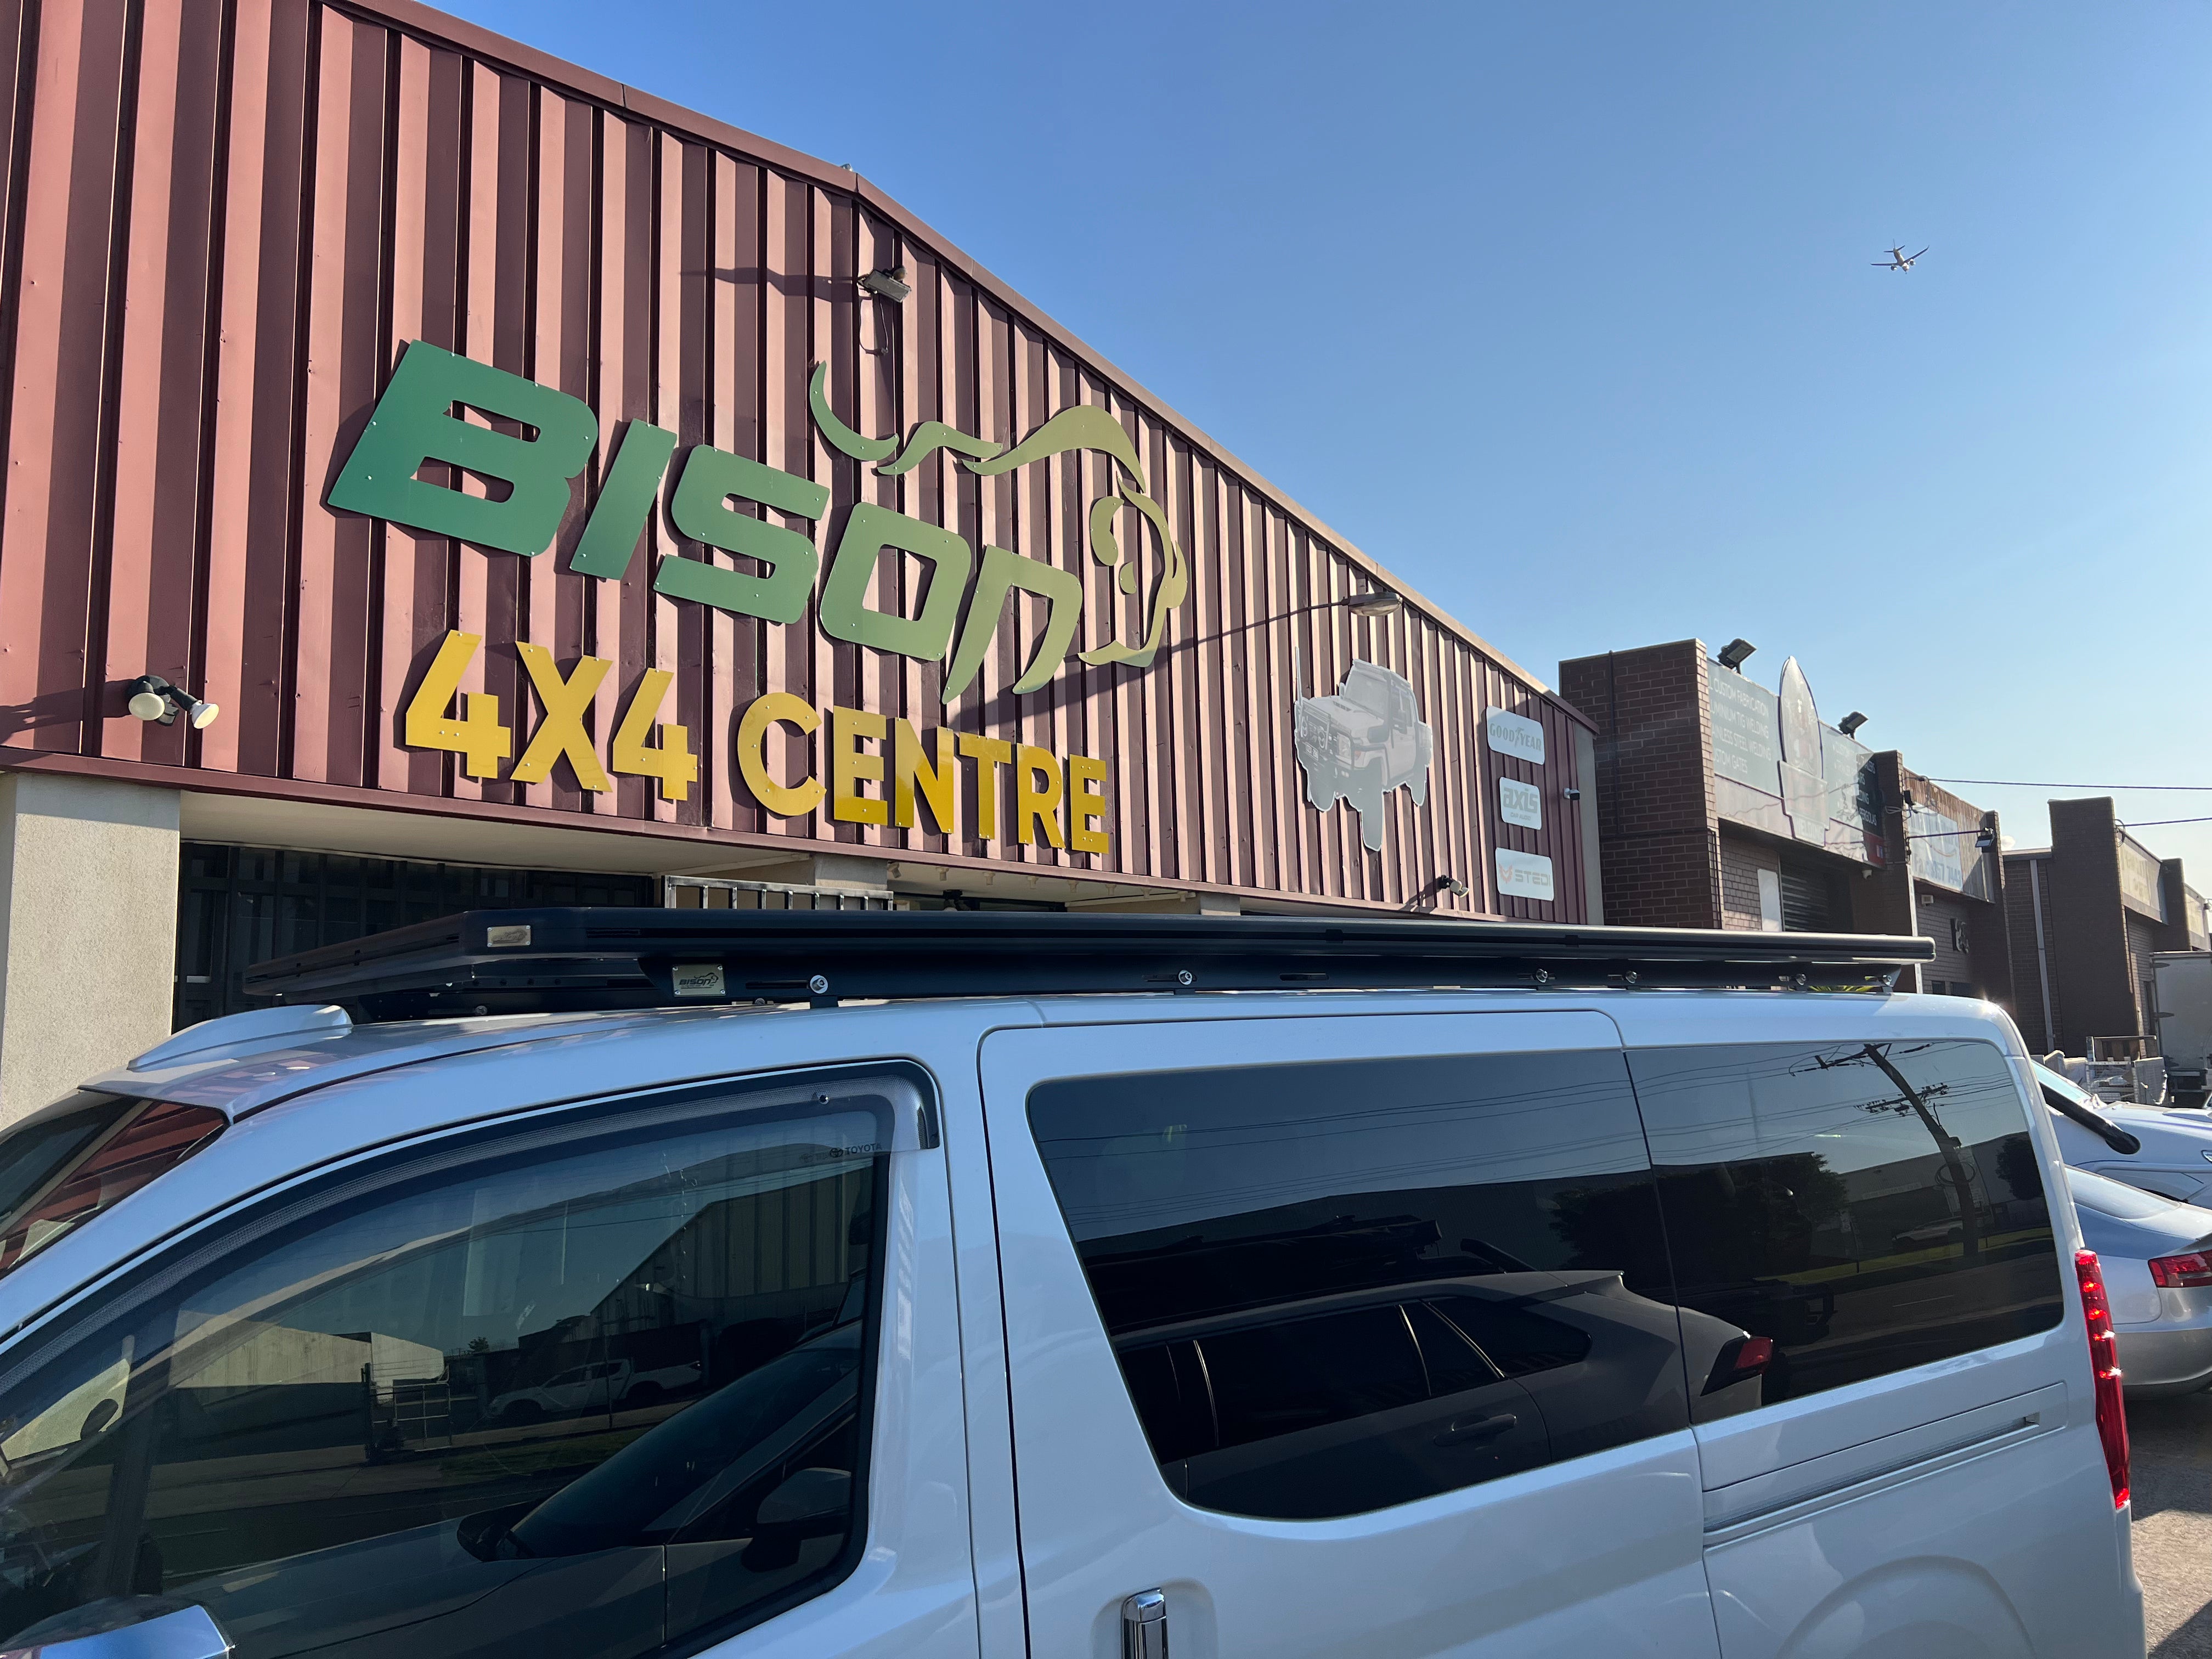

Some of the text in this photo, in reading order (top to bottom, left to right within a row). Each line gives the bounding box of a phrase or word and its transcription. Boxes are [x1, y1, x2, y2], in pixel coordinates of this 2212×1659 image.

[1713, 677, 1736, 701] CUSTOM
[1737, 690, 1769, 718] FABRICATION
[1710, 699, 1769, 740] UMINIUM TIG WELDING
[1489, 723, 1542, 752] GOODYEAR
[1712, 723, 1771, 761] AINLESS STEEL WELDING
[737, 692, 1110, 855] CENTRE
[1731, 754, 1748, 774] GATES
[1504, 787, 1538, 814] axis
[1515, 869, 1550, 887] STEDI
[845, 1142, 882, 1155] TOYOTA
